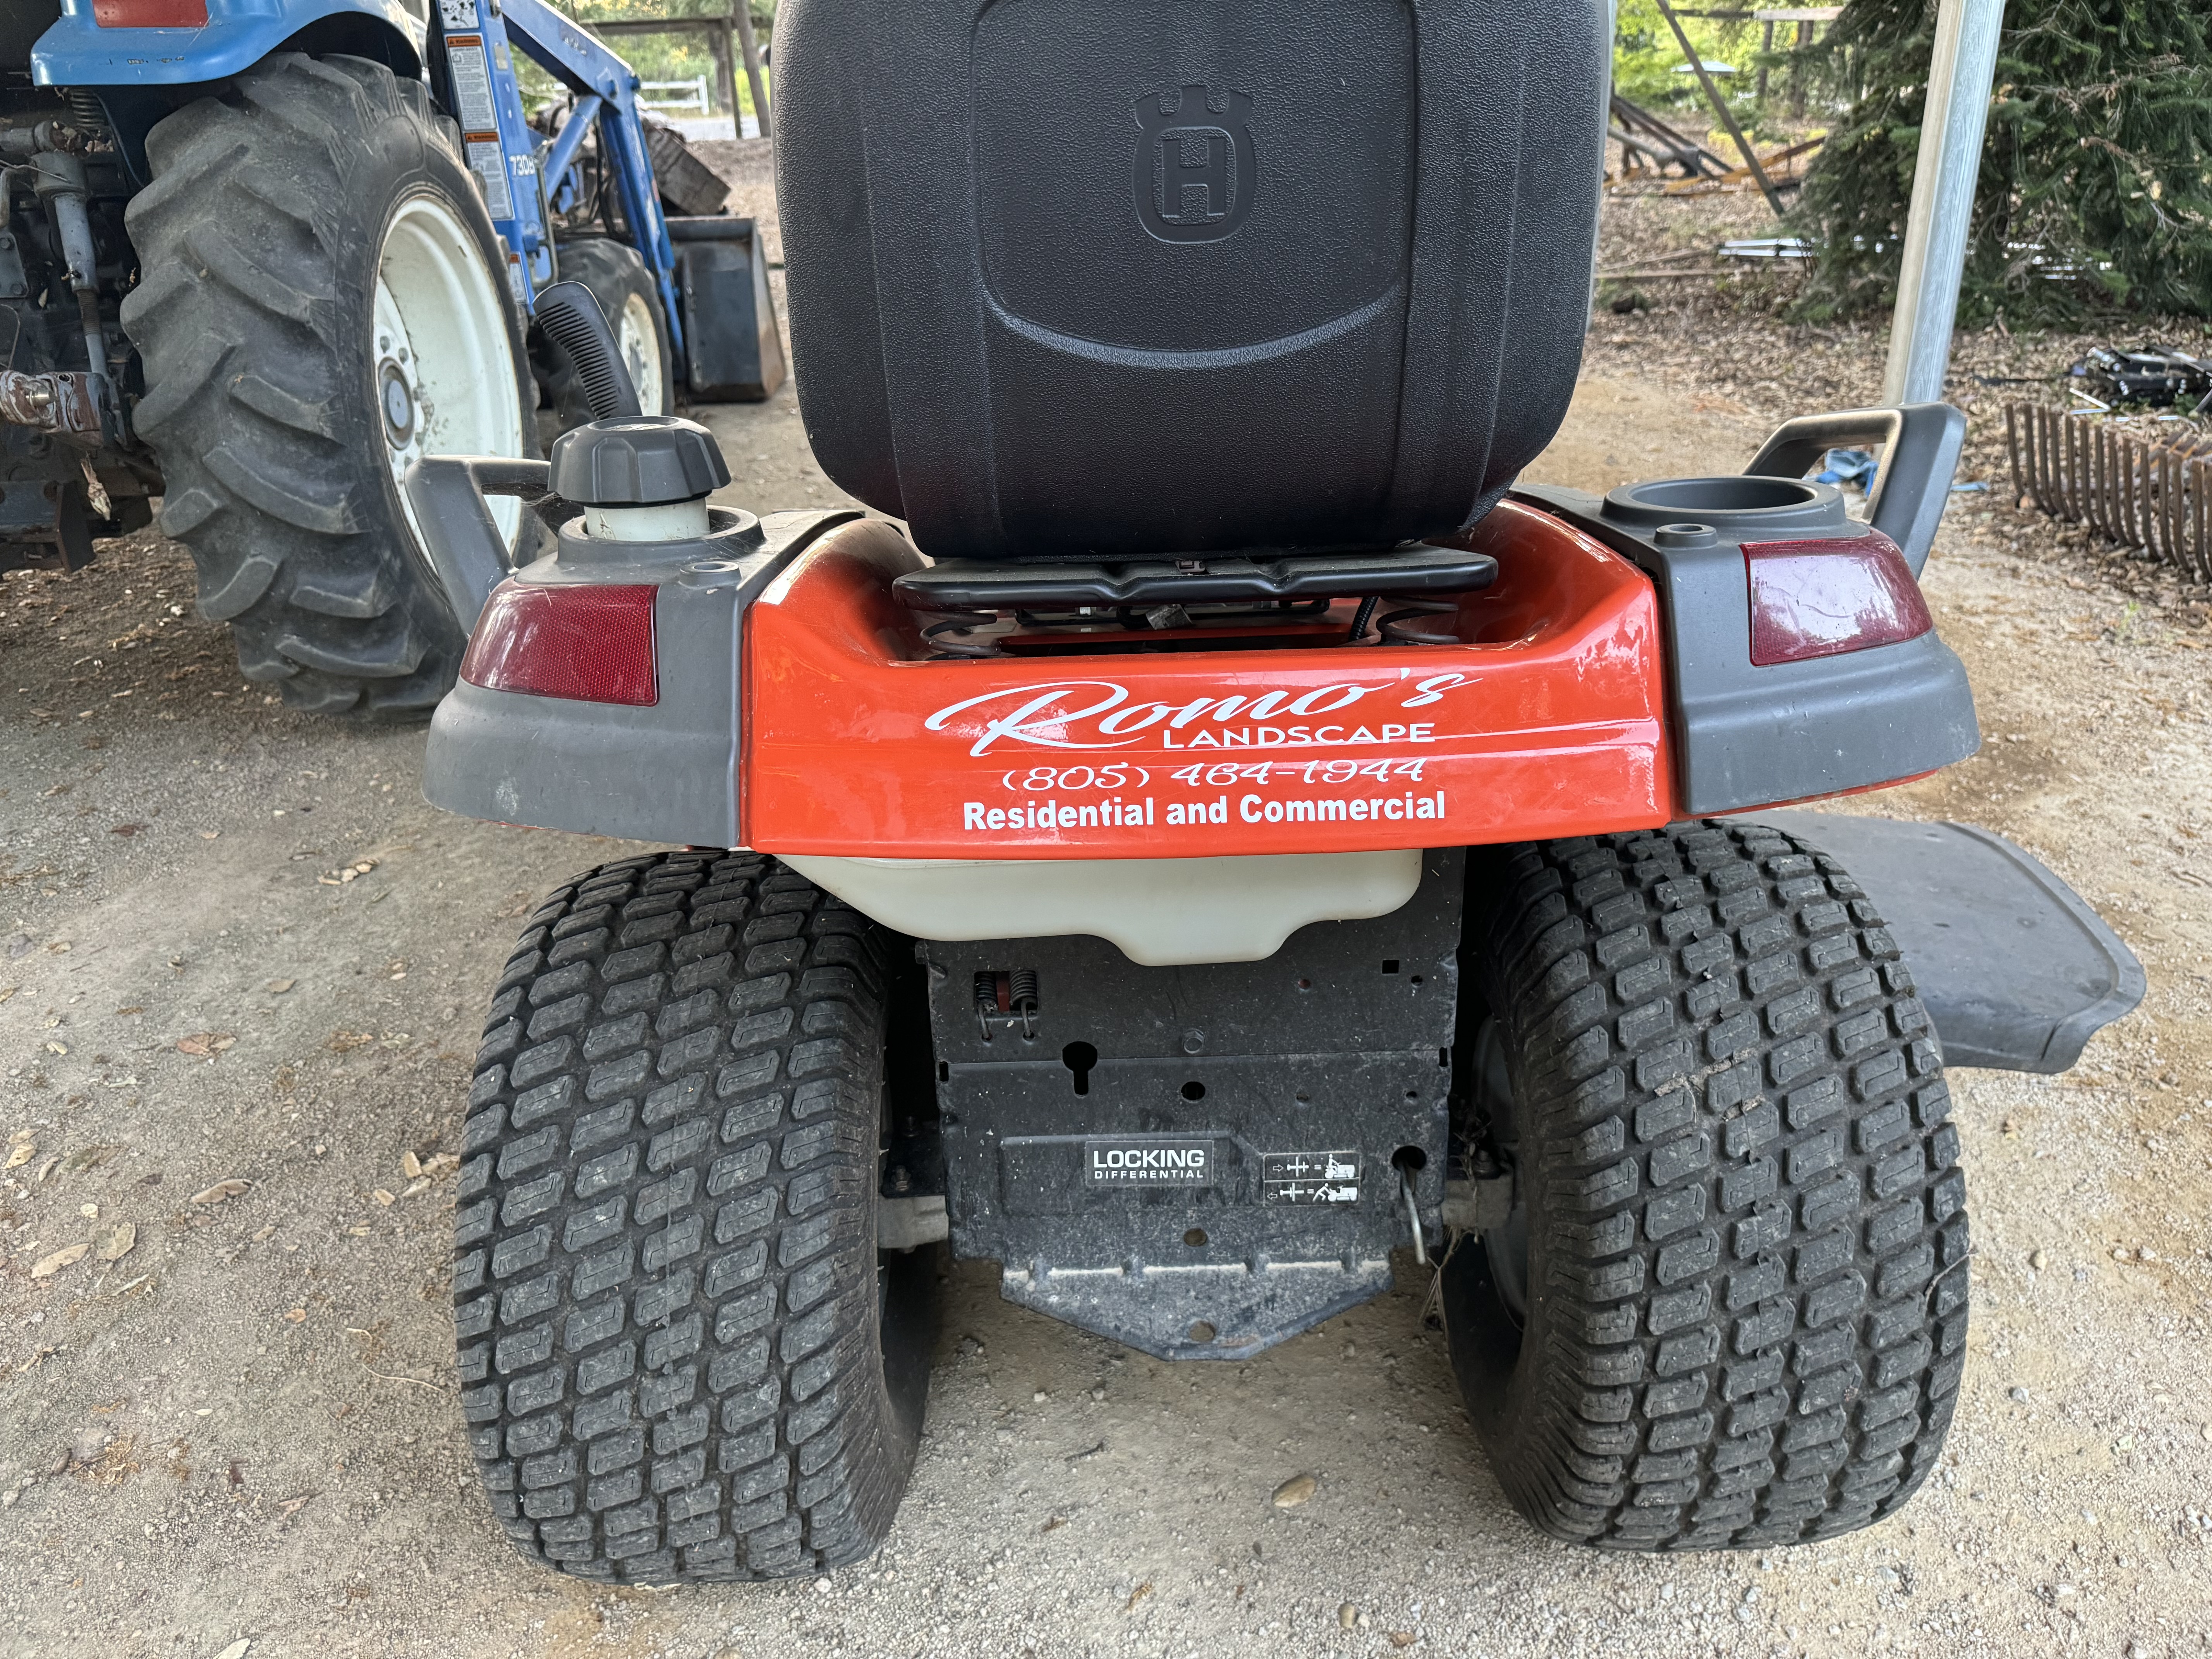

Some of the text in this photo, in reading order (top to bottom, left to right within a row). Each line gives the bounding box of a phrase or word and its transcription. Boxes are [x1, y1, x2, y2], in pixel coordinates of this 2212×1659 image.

[1161, 137, 1225, 218] H
[924, 667, 1484, 757] Romo's
[1163, 723, 1435, 749] LANDSCAPE
[1002, 757, 1428, 791] (805) 464-1944
[963, 790, 1445, 830] Residential and Commercial
[1093, 1149, 1205, 1169] LOCKING
[1094, 1169, 1204, 1180] DIFFERENTIAL
